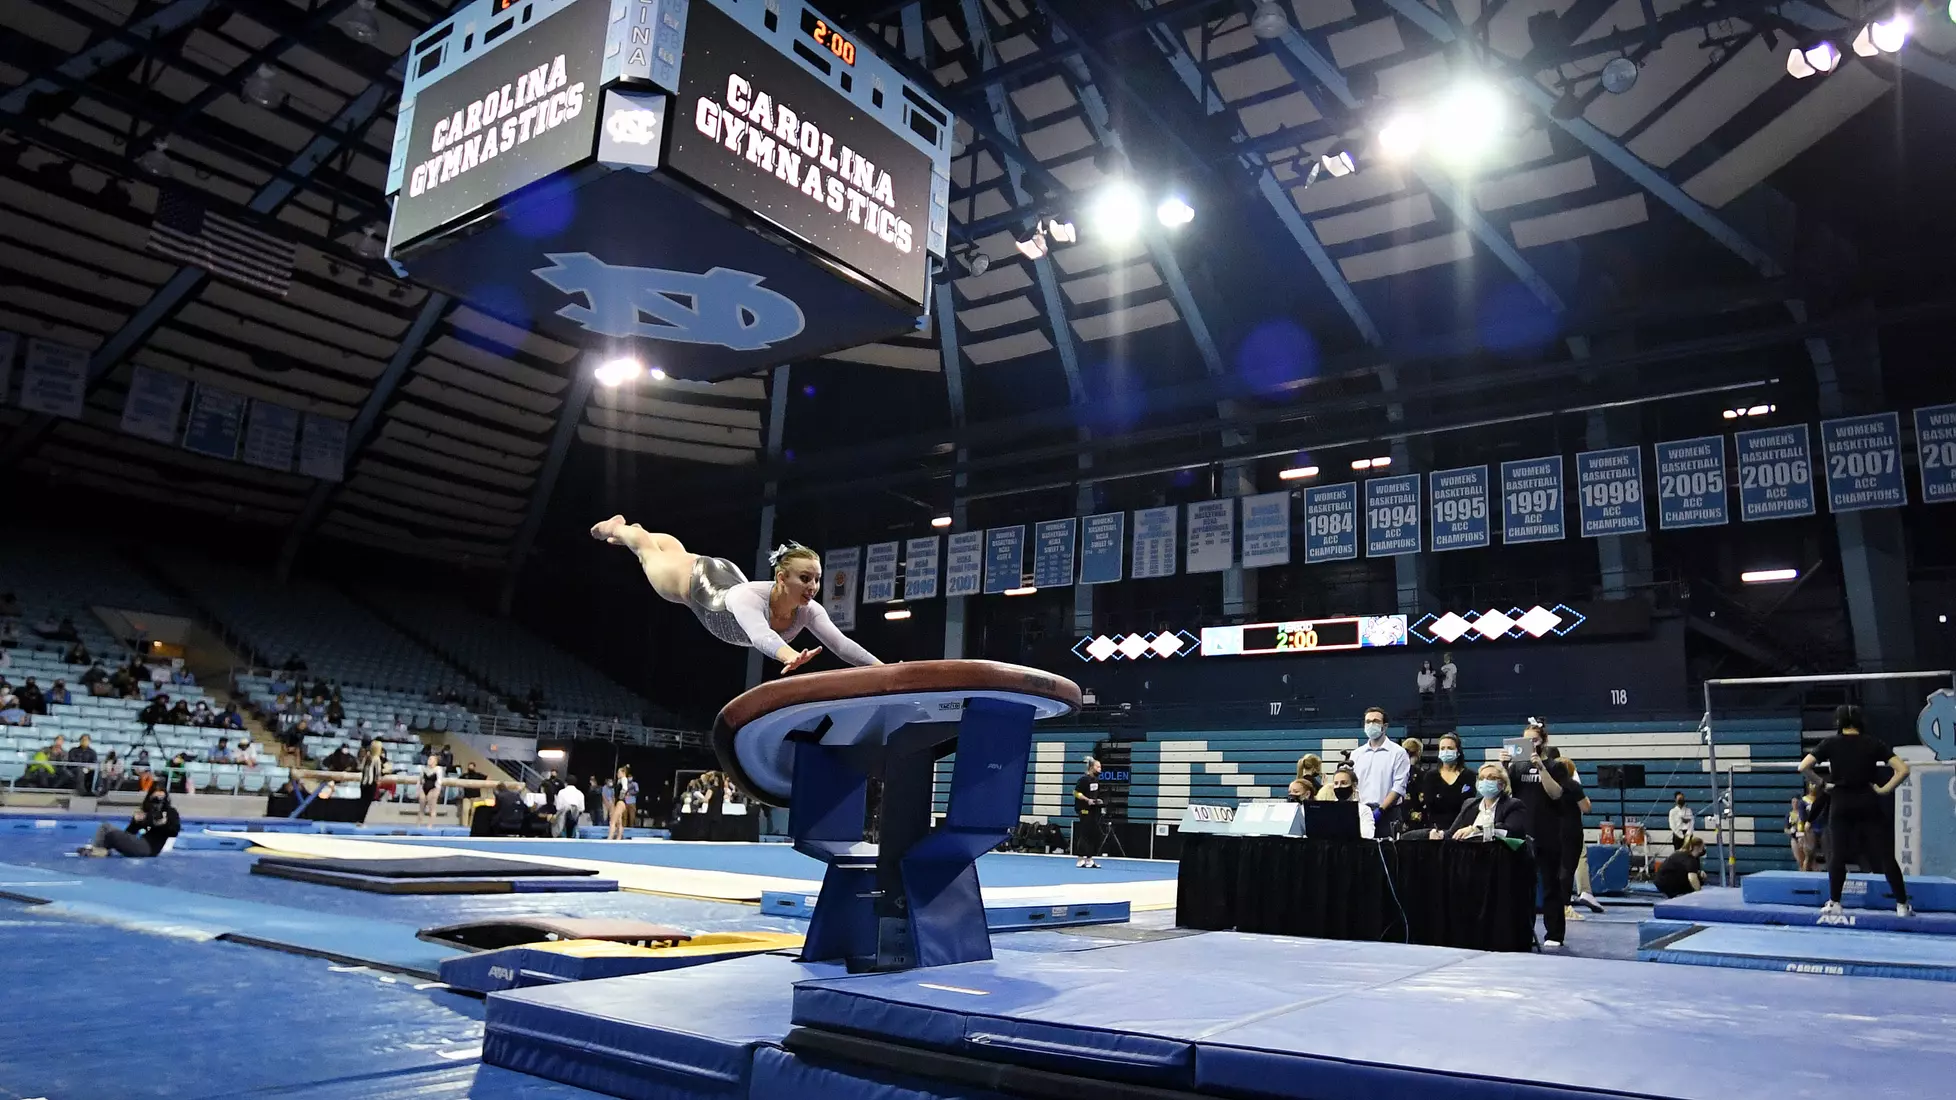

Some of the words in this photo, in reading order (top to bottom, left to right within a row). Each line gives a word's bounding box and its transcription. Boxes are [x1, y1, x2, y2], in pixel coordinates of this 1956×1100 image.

[813, 19, 855, 67] 2:00
[430, 53, 567, 154] CAROLINA
[408, 82, 585, 199] GYMNASTICS
[726, 73, 896, 208] CAROLINA
[695, 96, 913, 254] GYMNASTICS
[1829, 434, 1894, 452] BASKETBALL
[1742, 446, 1804, 463] BASKETBALL
[1661, 458, 1719, 473] BASKETBALL
[1830, 449, 1896, 480] 2007
[1582, 467, 1637, 482] BASKETBALL
[1742, 460, 1808, 489] 2006
[1506, 476, 1558, 491] BASKETBALL
[1660, 471, 1723, 498] 2005
[1854, 476, 1877, 490] ACC
[1369, 494, 1416, 507] BASKETBALL
[1434, 486, 1483, 500] BASKETBALL
[1581, 479, 1640, 507] 1998
[1765, 487, 1787, 499] ACC
[1834, 489, 1900, 505] CHAMPIONS
[1308, 501, 1352, 514] BASKETBALL
[1507, 488, 1558, 515] 1997
[1683, 496, 1703, 508] ACC
[1747, 498, 1809, 515] CHAMPIONS
[1369, 505, 1417, 529] 1994
[1434, 497, 1486, 523] 1995
[1603, 505, 1621, 517] ACC
[1665, 507, 1722, 522] CHAMPIONS
[1308, 512, 1353, 536] 1984
[1524, 513, 1542, 524] ACC
[1586, 516, 1640, 531] CHAMPIONS
[1385, 528, 1402, 539] ACC
[1452, 521, 1469, 532] ACC
[1508, 523, 1560, 537] CHAMPIONS
[1323, 535, 1339, 545] ACC
[1370, 538, 1416, 551] CHAMPIONS
[1436, 531, 1484, 545] CHAMPIONS
[1309, 544, 1353, 557] CHAMPIONS
[1276, 631, 1318, 649] 2:00
[1610, 688, 1628, 706] 118
[1269, 702, 1282, 716] 117
